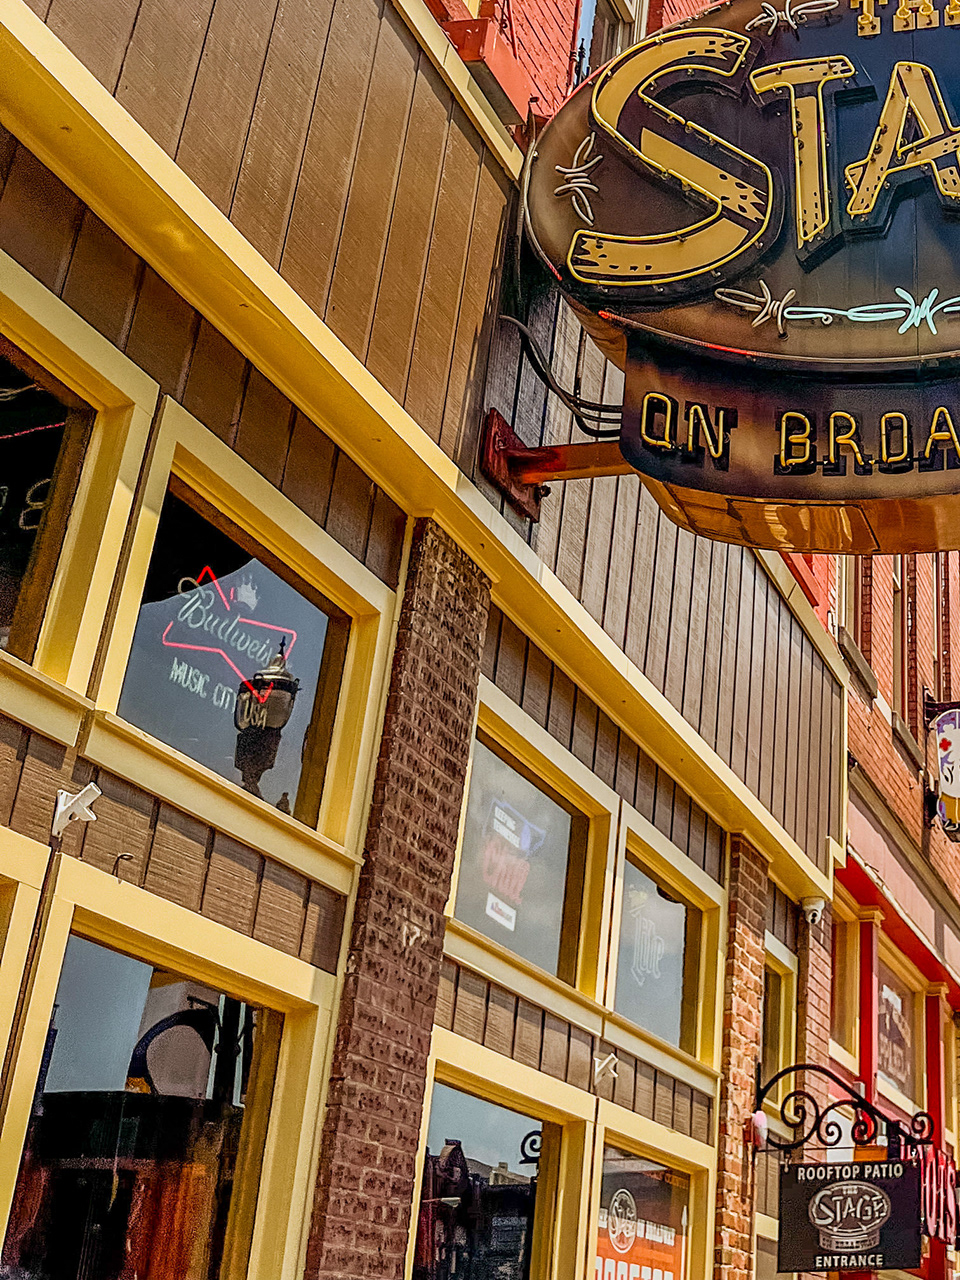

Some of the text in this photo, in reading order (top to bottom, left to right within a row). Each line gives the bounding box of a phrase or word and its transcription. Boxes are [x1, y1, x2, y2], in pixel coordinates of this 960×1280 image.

[640, 390, 729, 463] ON
[177, 576, 275, 669] Budweis
[168, 656, 211, 699] MUSIC
[797, 1163, 904, 1181] ROOFTOP PATIO
[814, 1189, 887, 1226] STAGE
[815, 1254, 884, 1269] ENTRANCE
